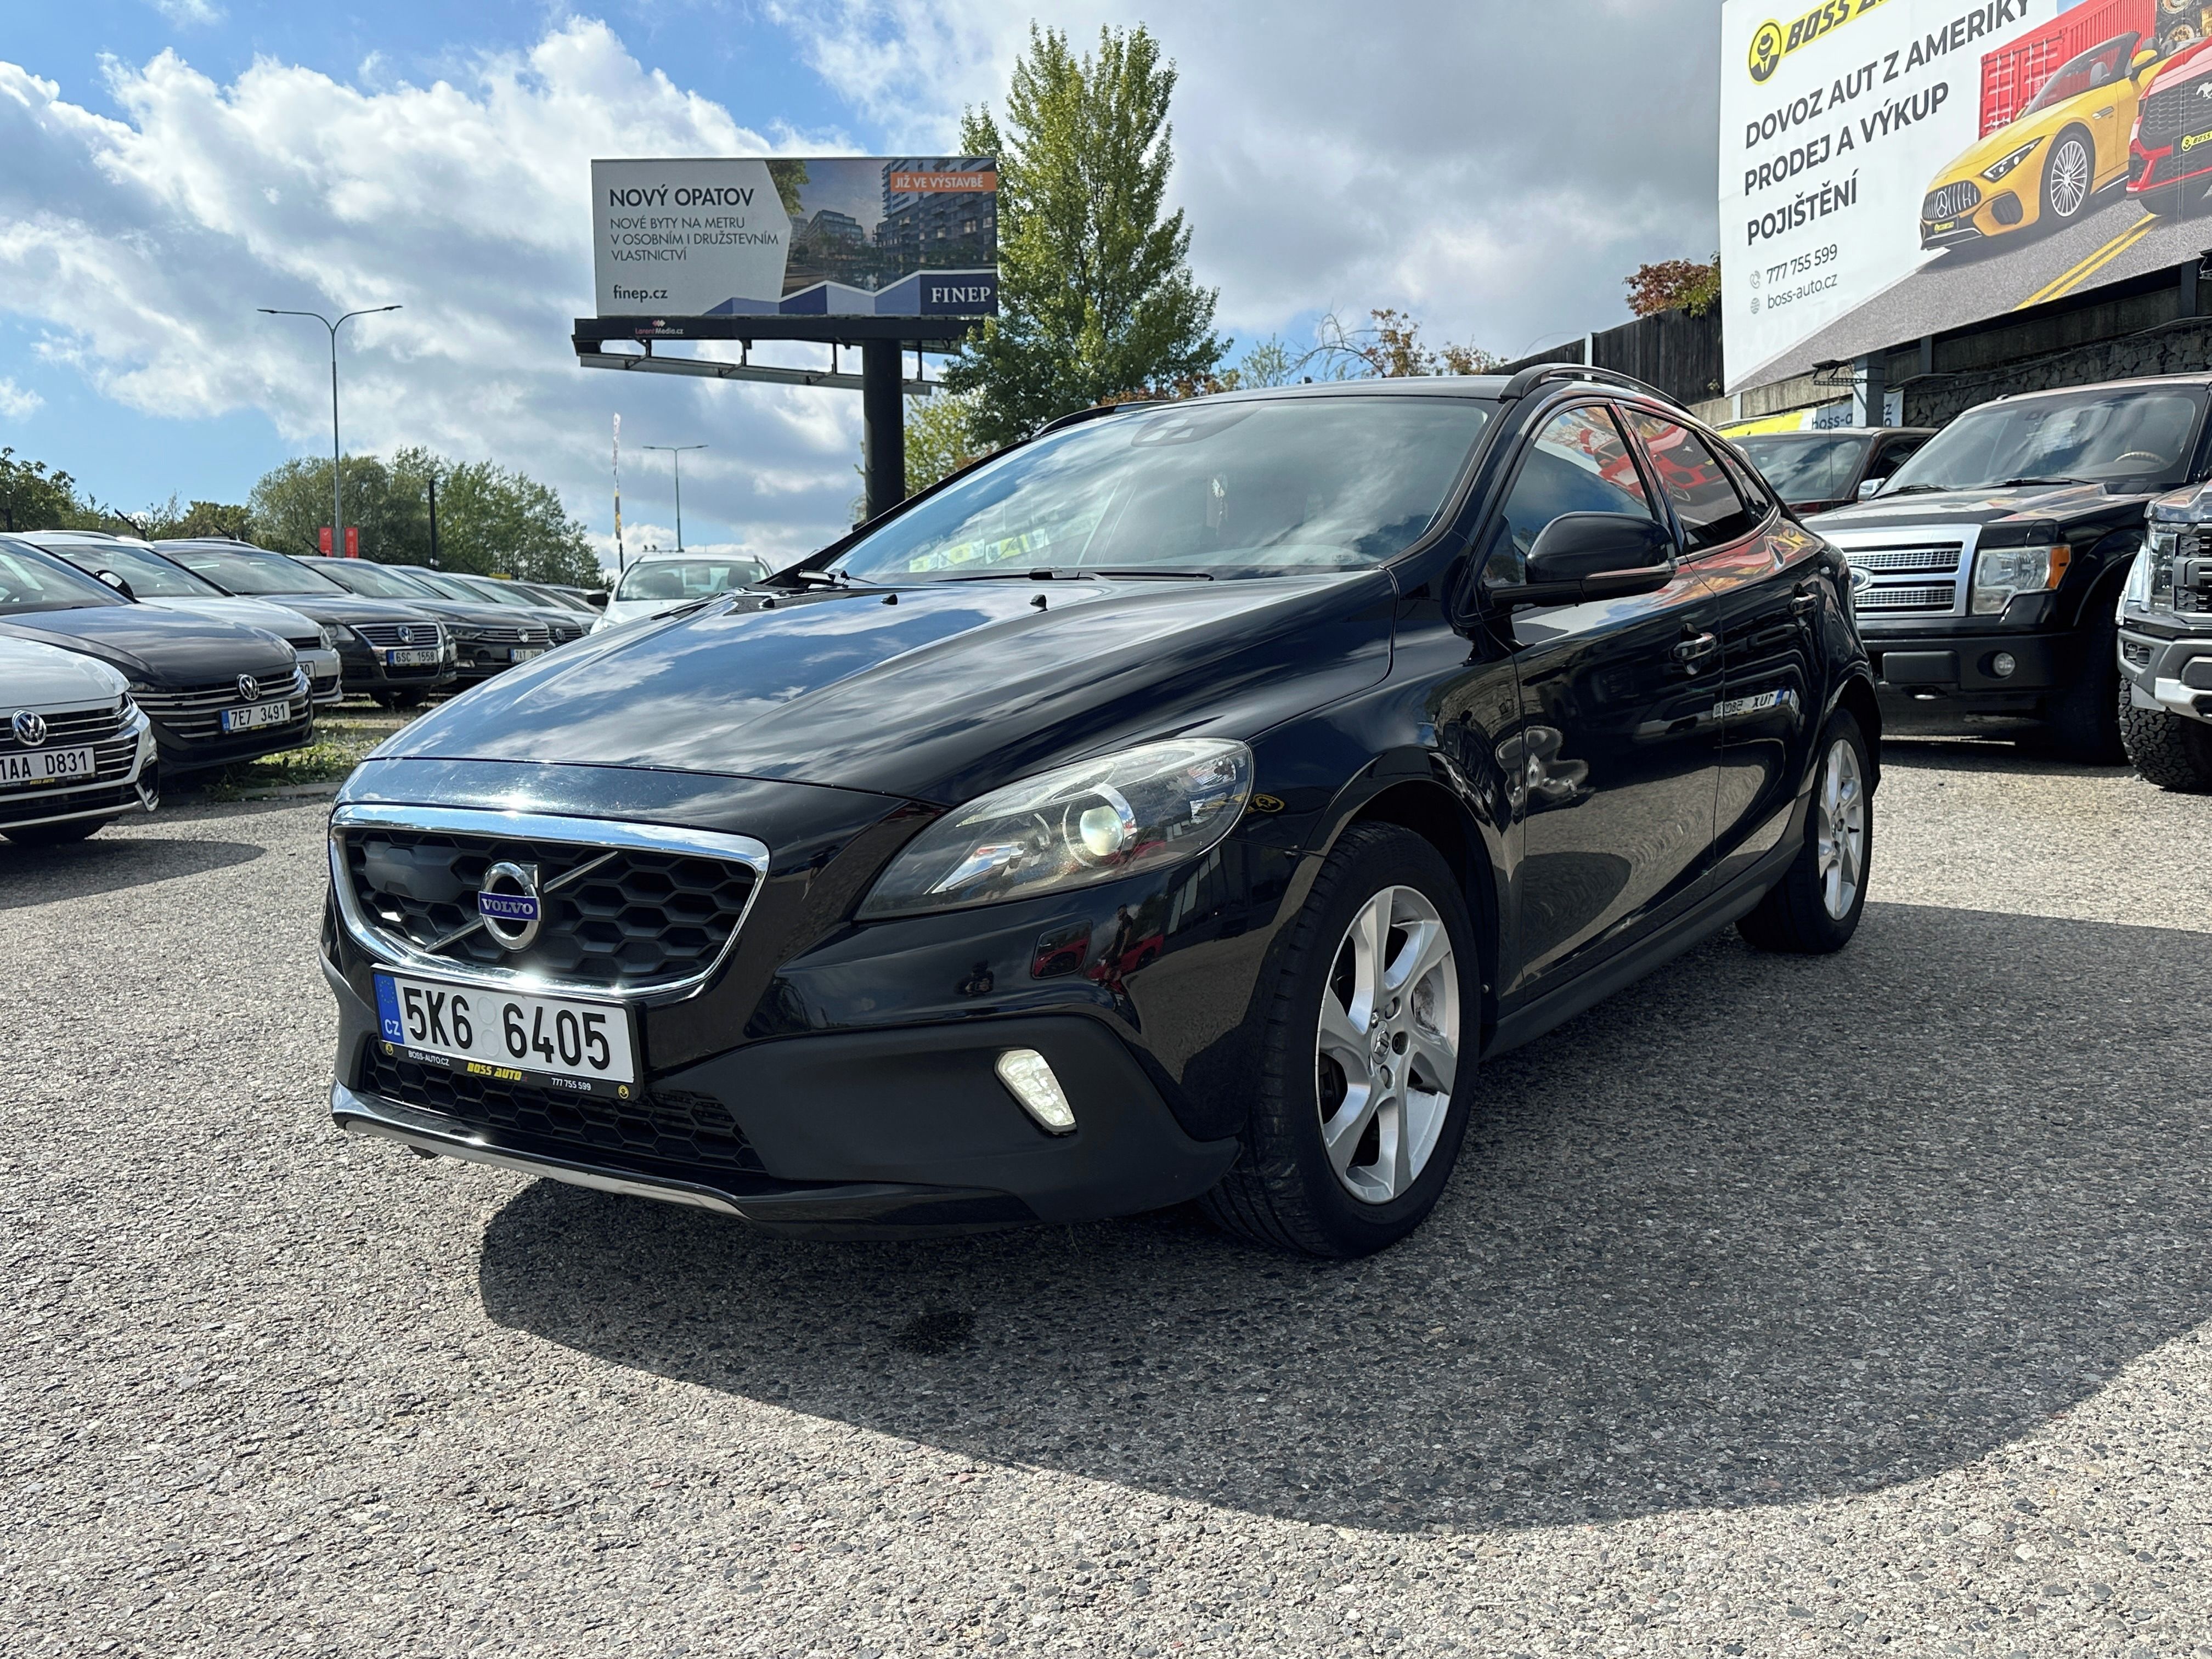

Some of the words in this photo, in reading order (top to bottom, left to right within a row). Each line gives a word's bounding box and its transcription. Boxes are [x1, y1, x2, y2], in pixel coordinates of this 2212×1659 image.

[1785, 0, 1850, 54] BOSS
[1746, 88, 1823, 149] DOVOZ
[1827, 60, 1877, 110] AUT
[1883, 50, 1899, 83] Z
[1745, 134, 1830, 196] PRODEJ
[1836, 126, 1854, 156] A
[1860, 82, 1949, 143] VÝKUP
[895, 174, 911, 188] JIŽ
[913, 177, 927, 188] VE
[929, 174, 984, 188] VÝSTAVBĚ
[610, 184, 668, 207] NOVÝ
[675, 188, 755, 206] OPATOV
[1747, 168, 1859, 246] POJIŠTĚNÍ
[611, 216, 646, 229] NOVÉ
[651, 217, 678, 229] BYTY
[682, 217, 701, 228] NA
[705, 217, 745, 228] METRU
[611, 234, 619, 245] V
[623, 231, 684, 245] OSOBNÍM
[686, 234, 690, 245] I
[694, 230, 778, 245] DRUŽSTEVNÍM
[611, 247, 687, 261] VLASTNICTVÍ
[1767, 262, 1787, 284] 777
[1790, 253, 1811, 275] 755
[1814, 244, 1837, 266] 599
[613, 284, 668, 302] finep.cz
[931, 286, 991, 303] FINEP
[1768, 274, 1838, 309] boss-auto.cz
[396, 652, 411, 662] 6SC
[232, 709, 251, 727] 7E7
[261, 704, 285, 721] 3491
[0, 757, 32, 780] 1AA
[44, 751, 87, 775] D831
[481, 898, 534, 915] VOLVO
[385, 1019, 400, 1036] CZ
[403, 986, 472, 1049] 5K6
[503, 1003, 610, 1070] 6405
[408, 1050, 450, 1066] BOSS-AUTO.CZ
[467, 1062, 492, 1076] BOSS
[494, 1067, 522, 1081] AUTO
[551, 1077, 563, 1086] 777
[563, 1079, 577, 1088] 755
[578, 1081, 591, 1091] 599
